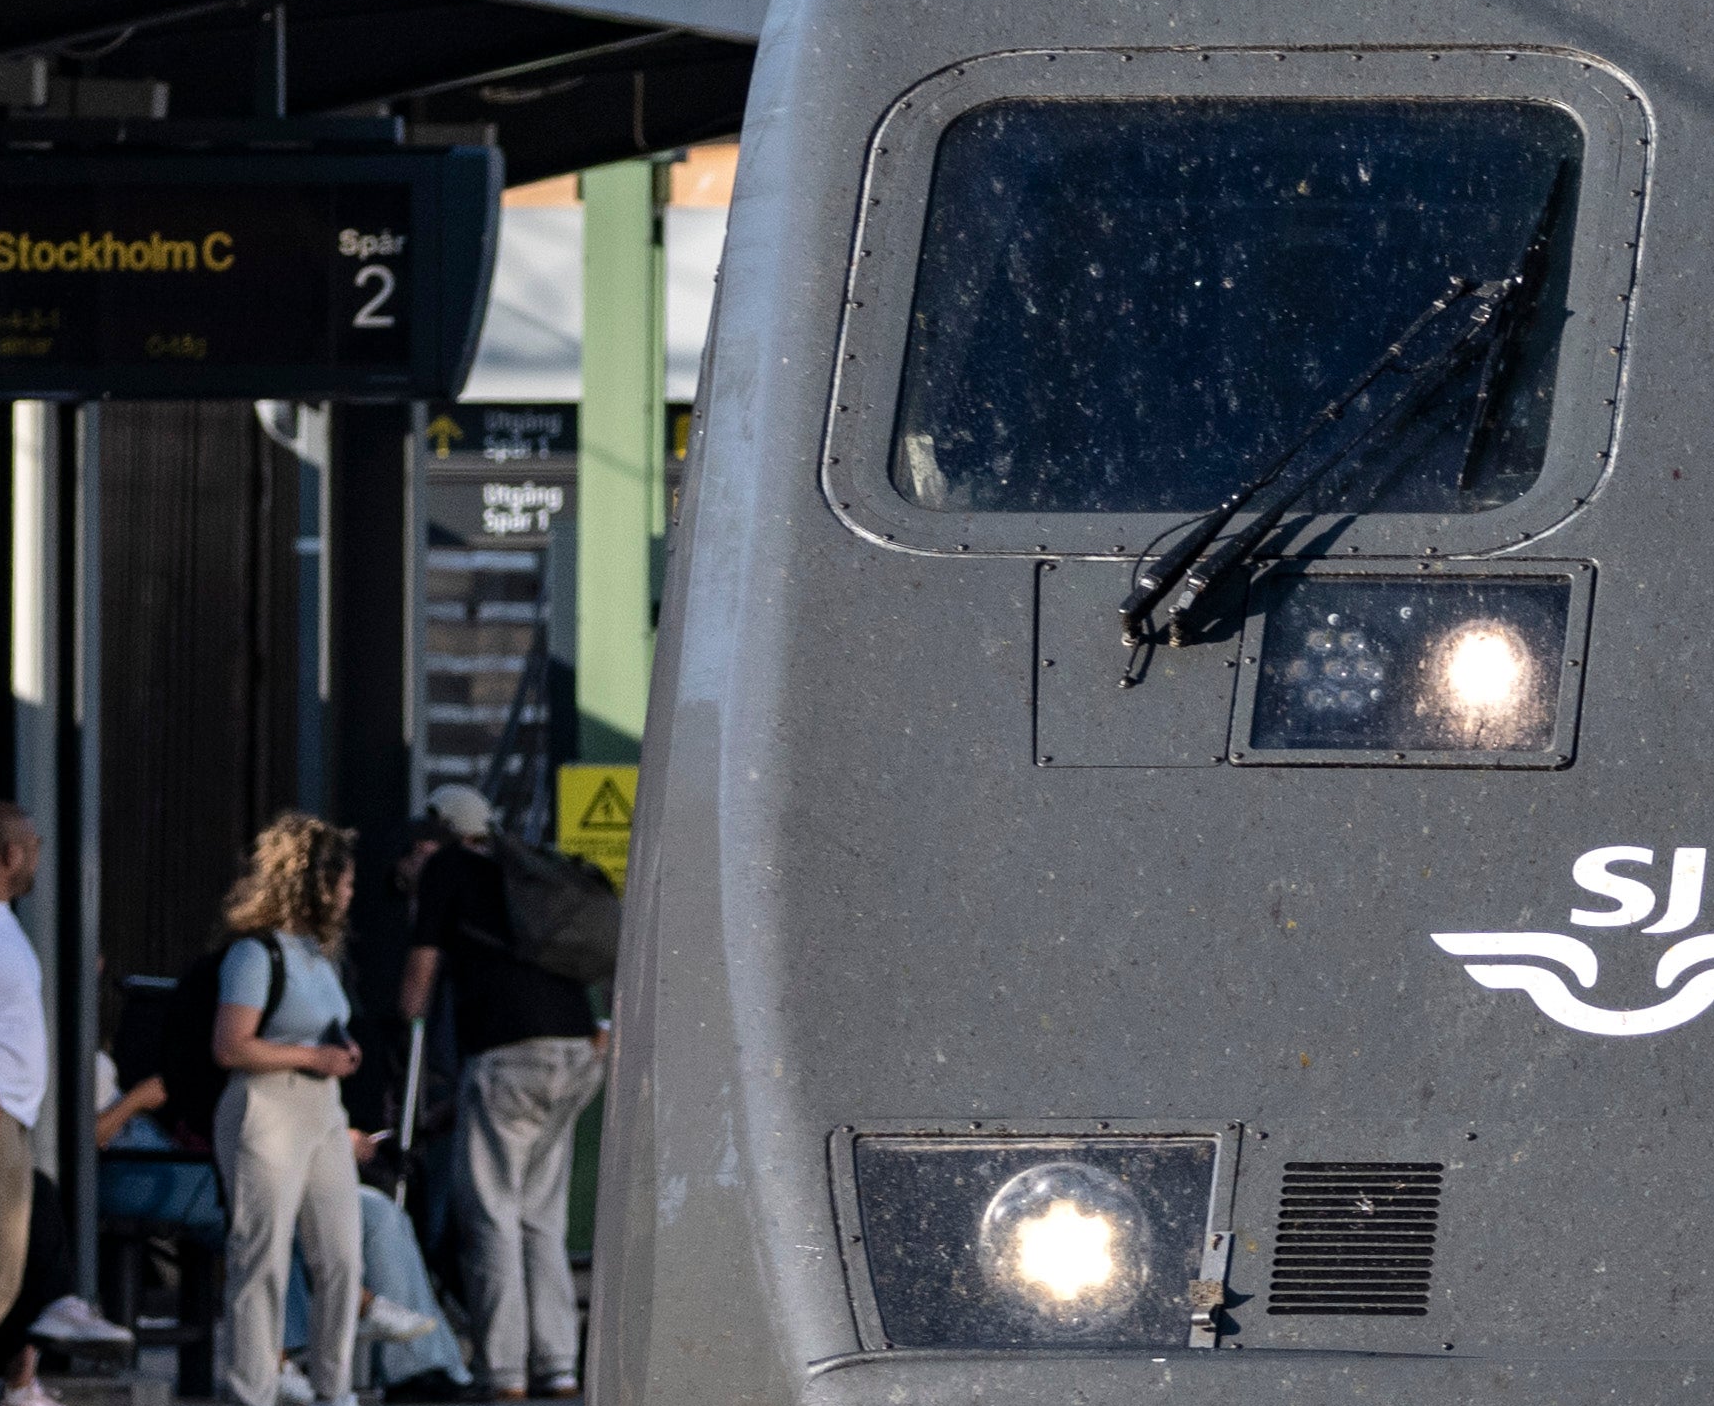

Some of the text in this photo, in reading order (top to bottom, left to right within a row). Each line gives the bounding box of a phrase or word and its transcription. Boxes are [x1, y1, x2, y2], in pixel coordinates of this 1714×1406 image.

[200, 230, 235, 272] C
[338, 227, 406, 260] Spår
[352, 264, 396, 328] 2
[483, 481, 564, 513] Utgång
[1569, 844, 1707, 934] SJ
